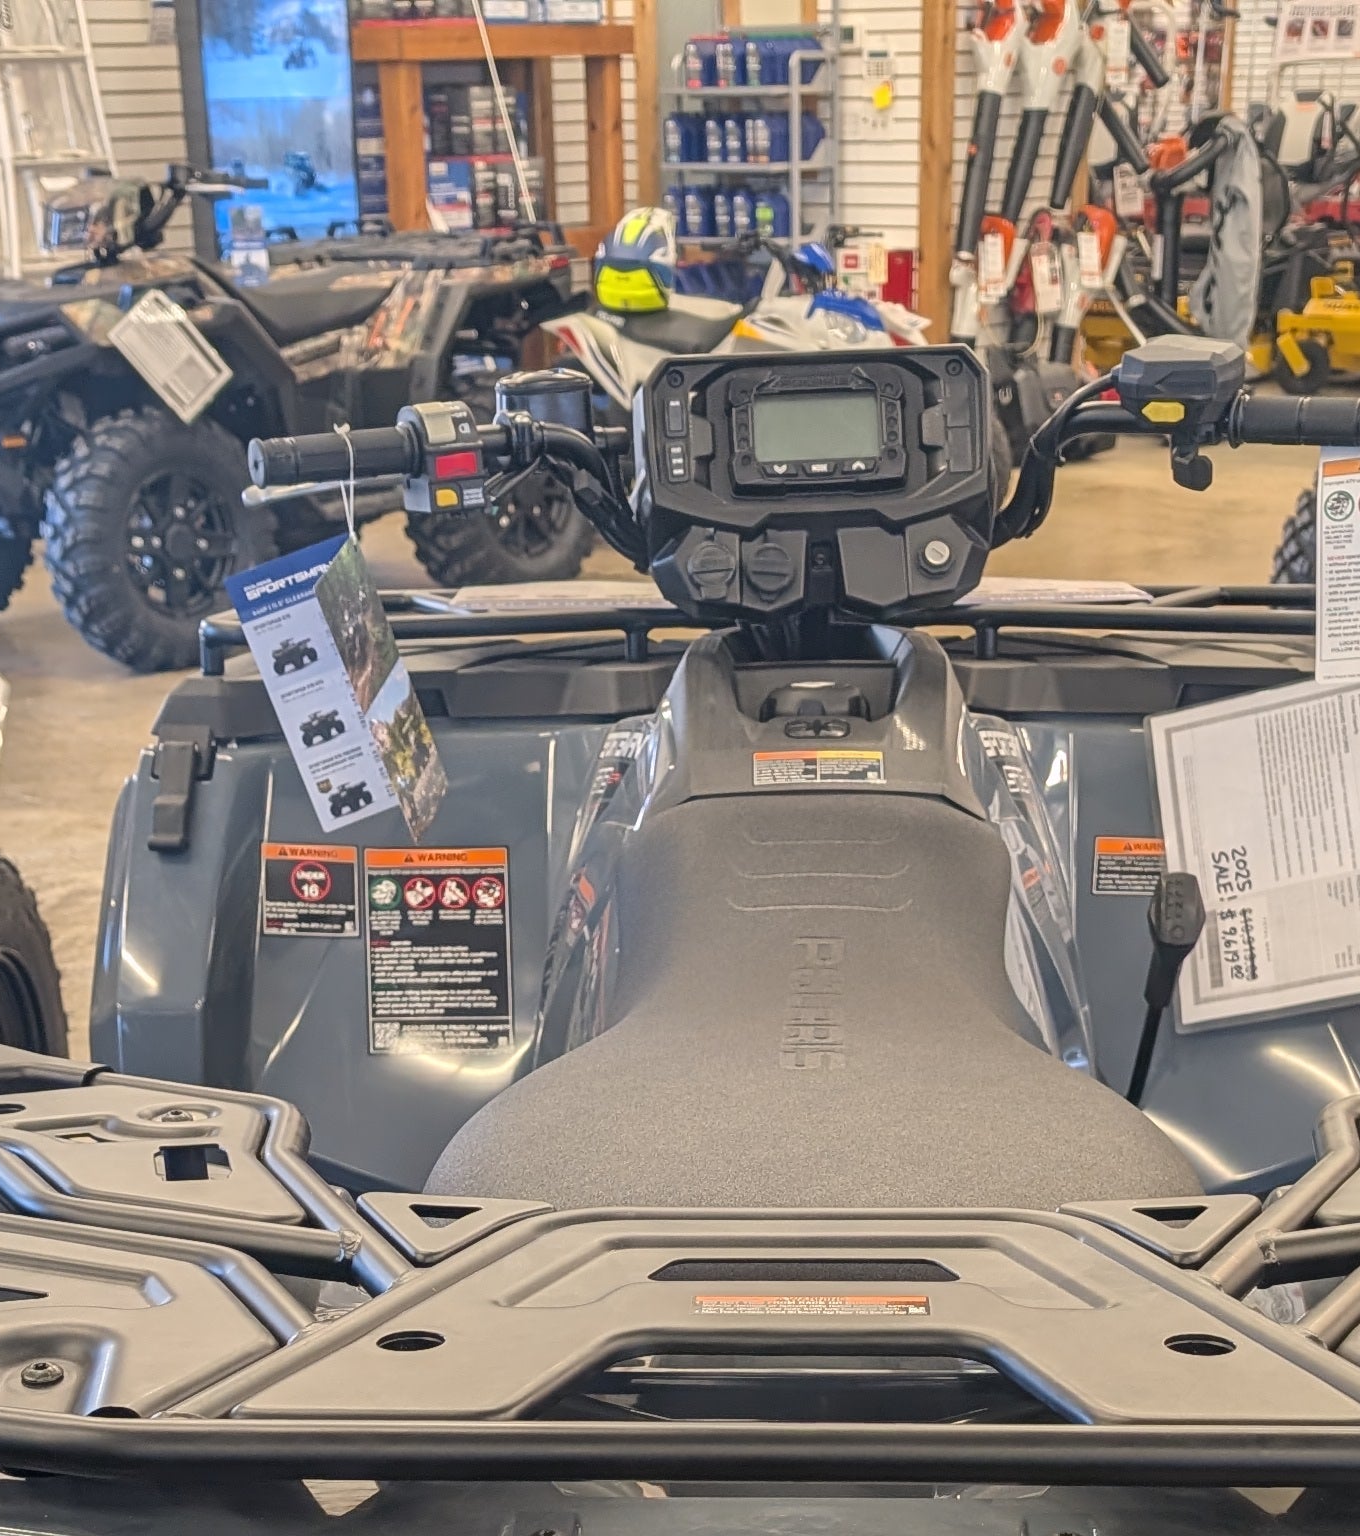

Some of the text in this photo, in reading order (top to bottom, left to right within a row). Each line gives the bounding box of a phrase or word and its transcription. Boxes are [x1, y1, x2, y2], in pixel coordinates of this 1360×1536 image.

[289, 847, 338, 858] WARNING
[417, 852, 468, 862] WARNING
[1211, 851, 1238, 902] SALE!
[1231, 845, 1252, 892] 2025
